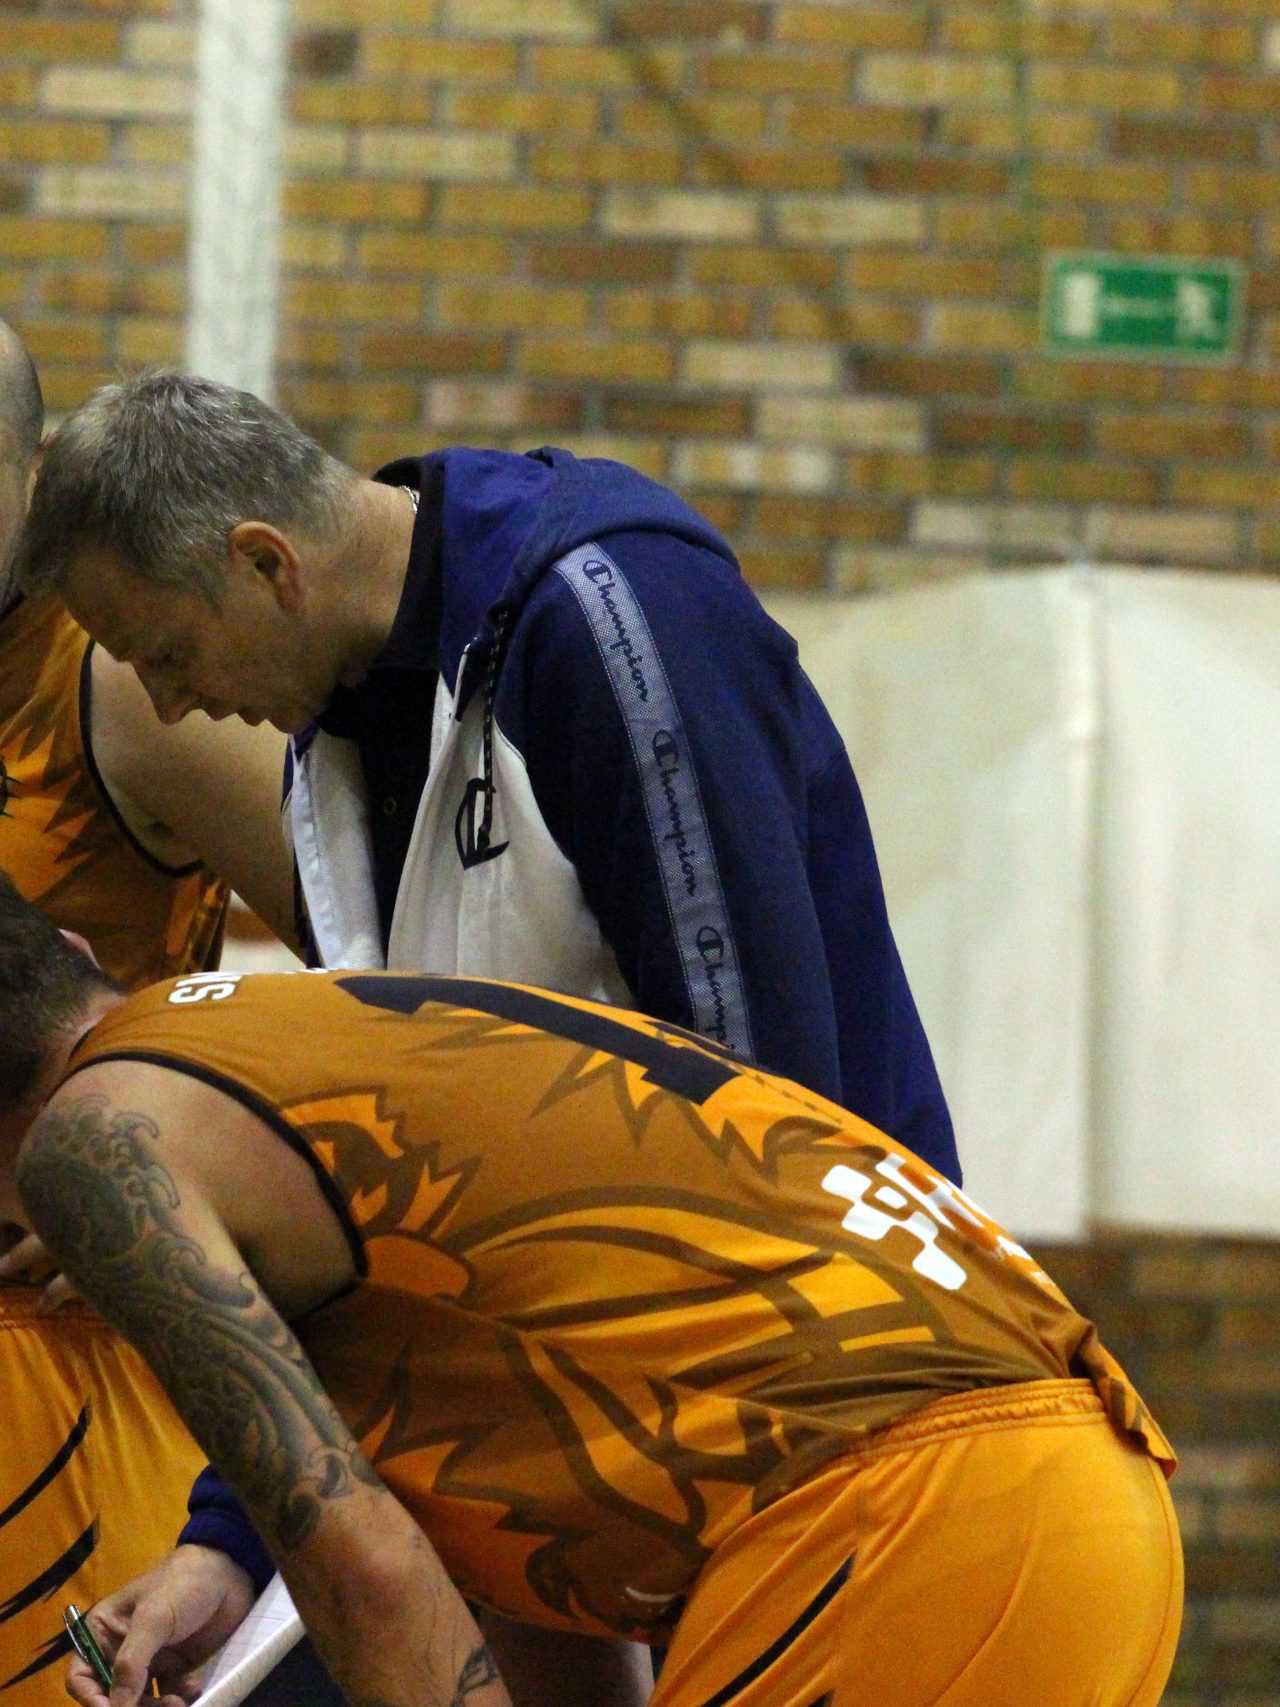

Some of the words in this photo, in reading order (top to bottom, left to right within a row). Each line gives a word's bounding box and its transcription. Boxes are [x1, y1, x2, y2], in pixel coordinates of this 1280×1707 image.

[582, 560, 649, 702] Champion
[652, 729, 696, 896] Champion
[696, 925, 737, 1050] Champ
